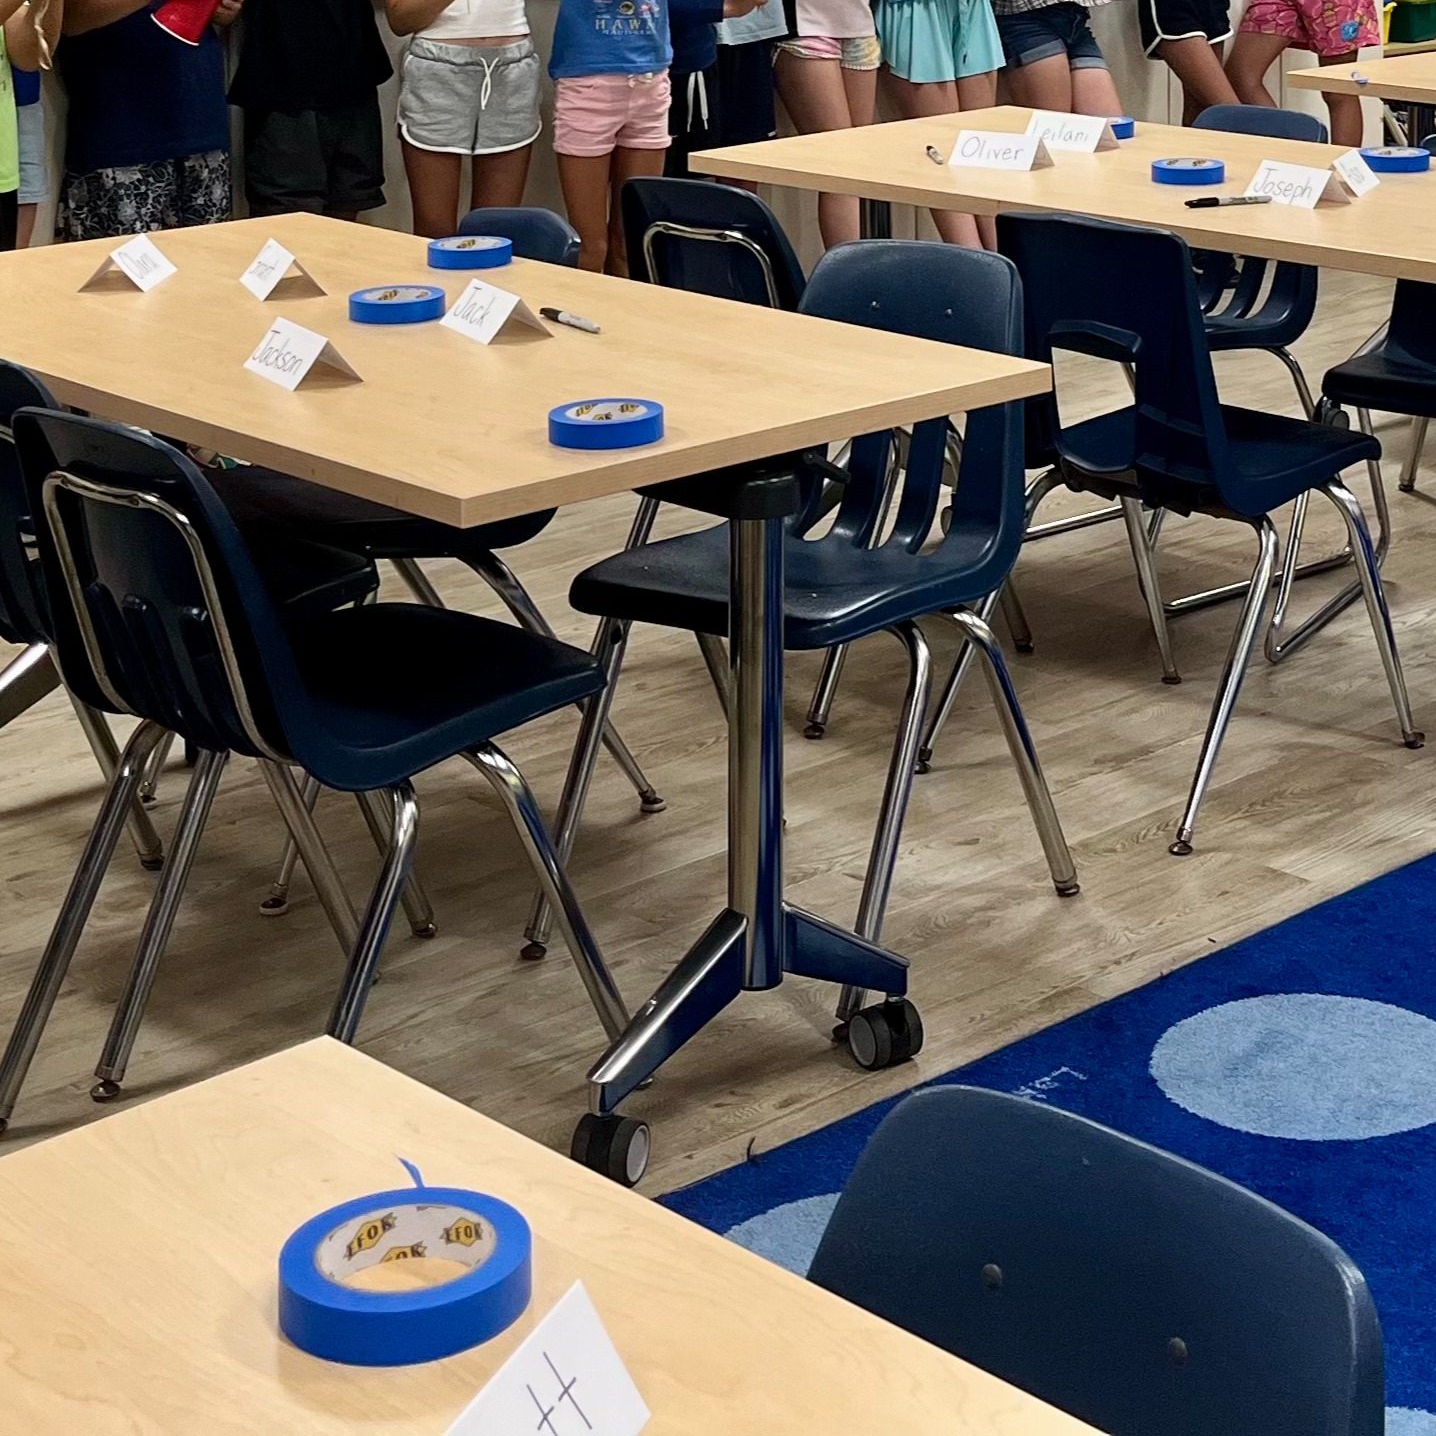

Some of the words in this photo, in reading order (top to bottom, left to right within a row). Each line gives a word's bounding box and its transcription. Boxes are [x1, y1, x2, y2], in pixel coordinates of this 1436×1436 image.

[960, 136, 1024, 162] Oliver
[1253, 167, 1312, 205] Joseph
[453, 286, 491, 326] Jack
[252, 329, 303, 376] Jackson
